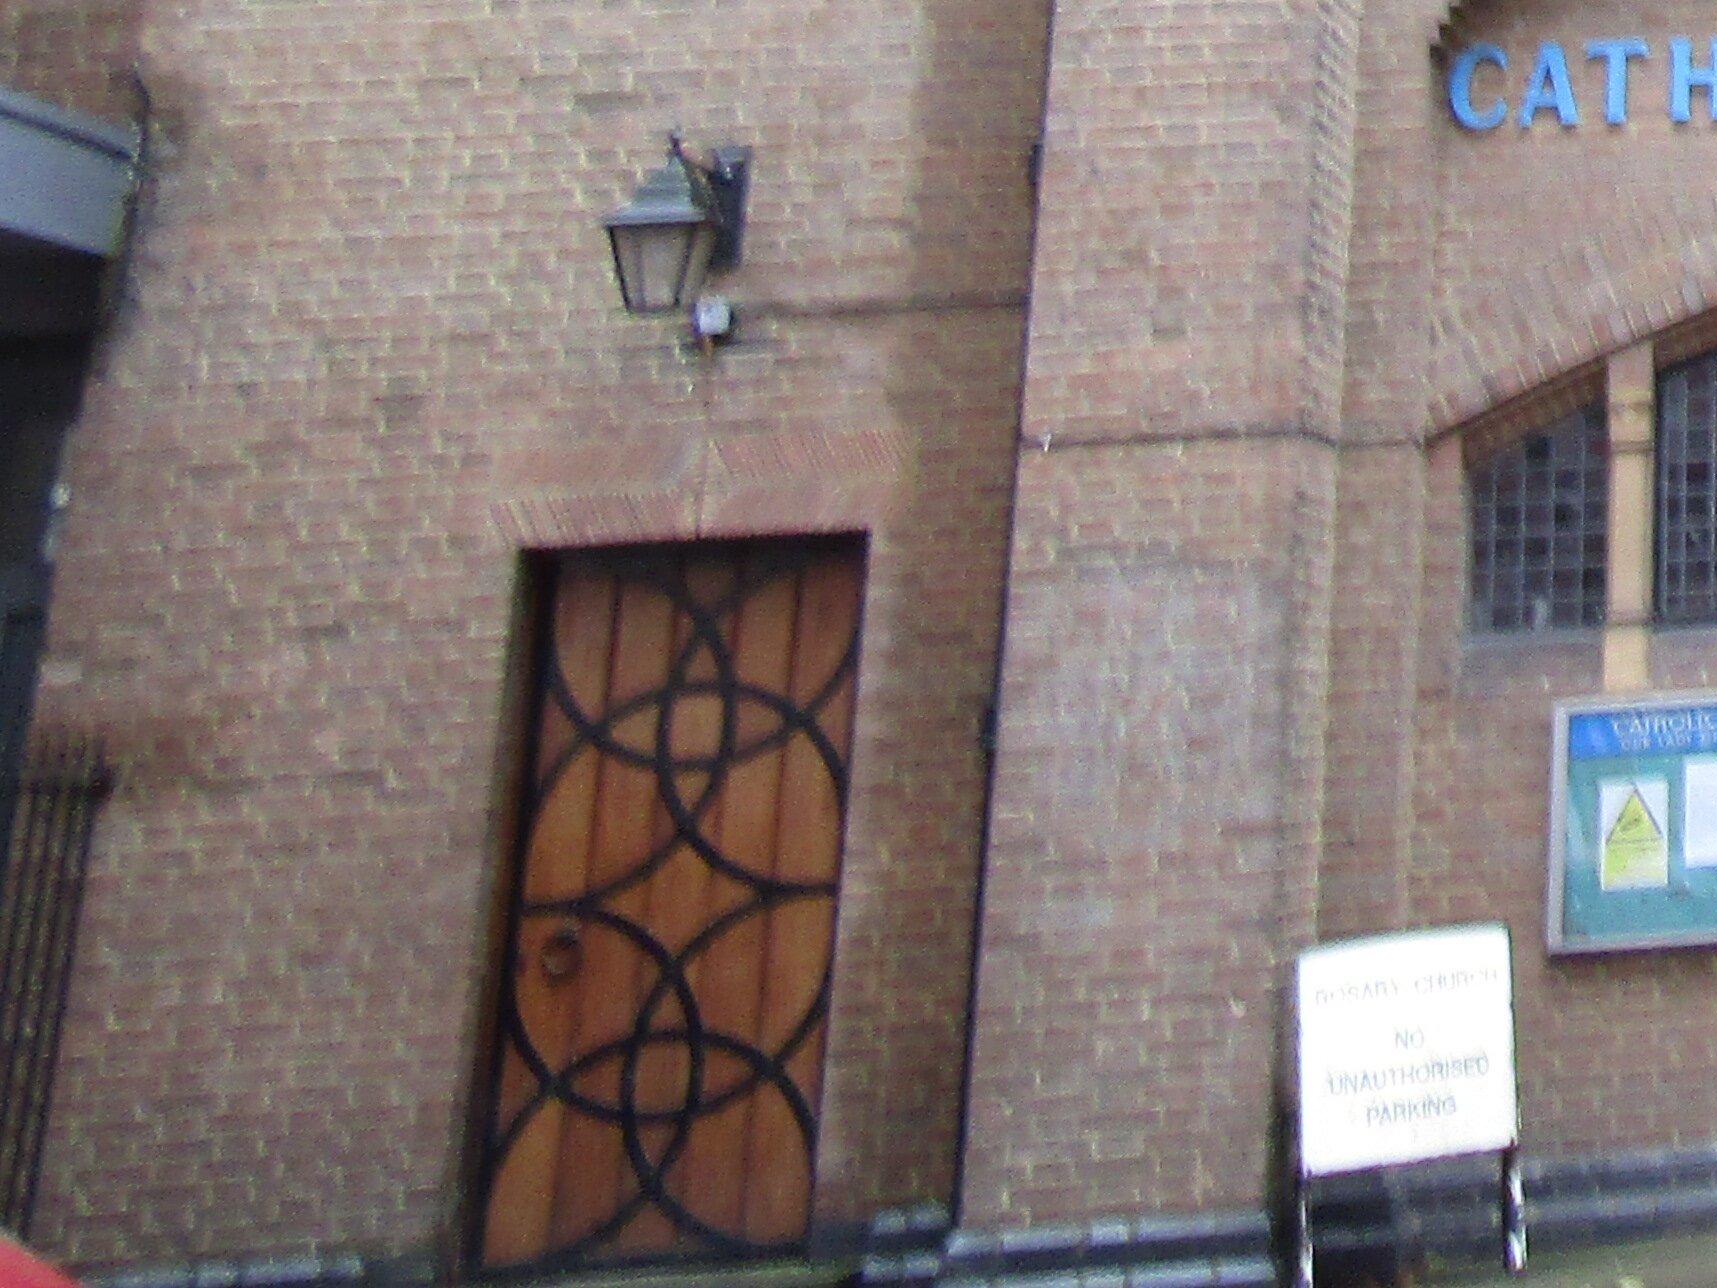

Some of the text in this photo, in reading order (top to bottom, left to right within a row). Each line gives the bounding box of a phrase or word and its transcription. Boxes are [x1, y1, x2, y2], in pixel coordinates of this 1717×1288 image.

[1393, 1026, 1425, 1049] NO
[1327, 1054, 1489, 1096] UNAUTHORISED
[1364, 1095, 1457, 1128] PARKING
